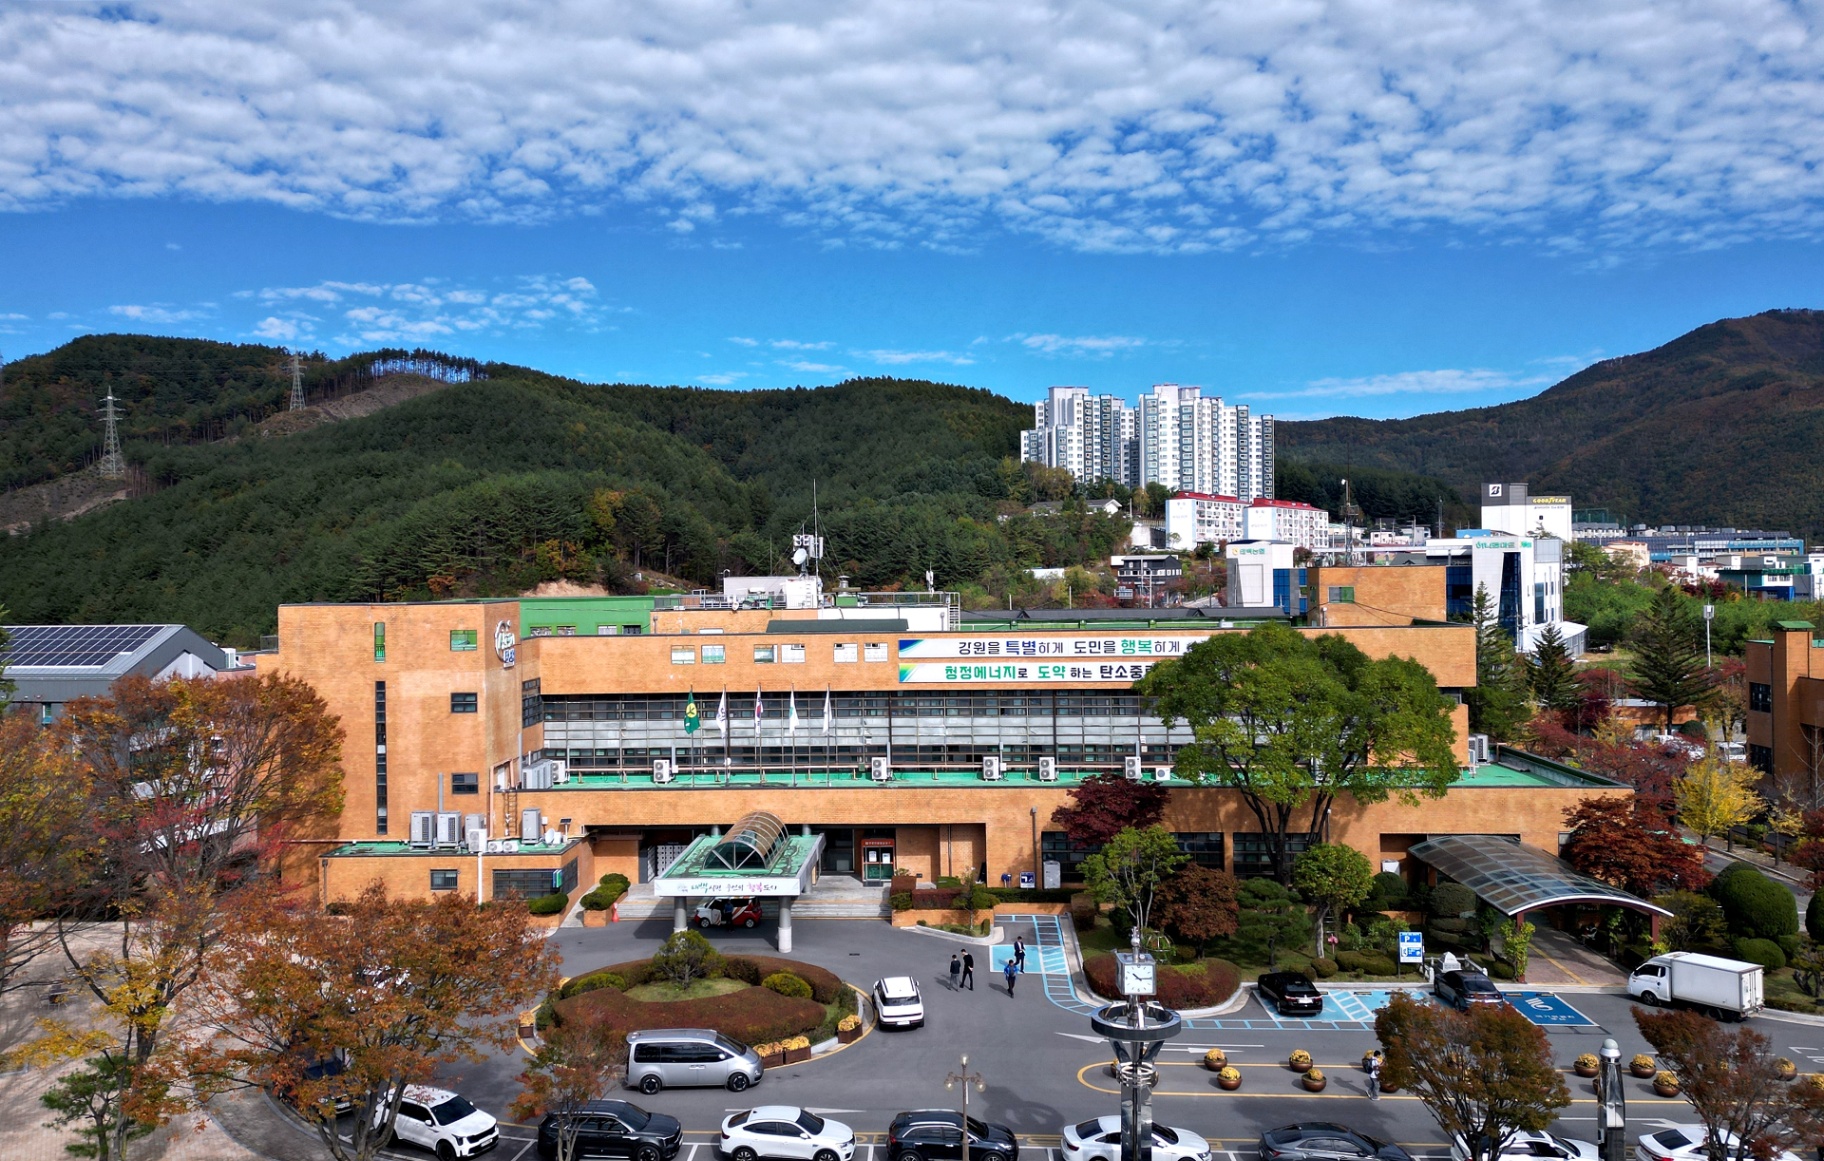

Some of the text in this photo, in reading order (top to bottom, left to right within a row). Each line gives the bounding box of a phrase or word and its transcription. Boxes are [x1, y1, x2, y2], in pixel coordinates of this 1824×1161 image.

[958, 641, 1000, 655] 강원을
[1005, 640, 1064, 655] 특별하게
[1074, 640, 1116, 654] 도민을
[1121, 639, 1180, 655] 행복하게
[945, 665, 1028, 680] 청정에너지로
[1038, 665, 1065, 679] 도약
[1070, 667, 1093, 679] 하는
